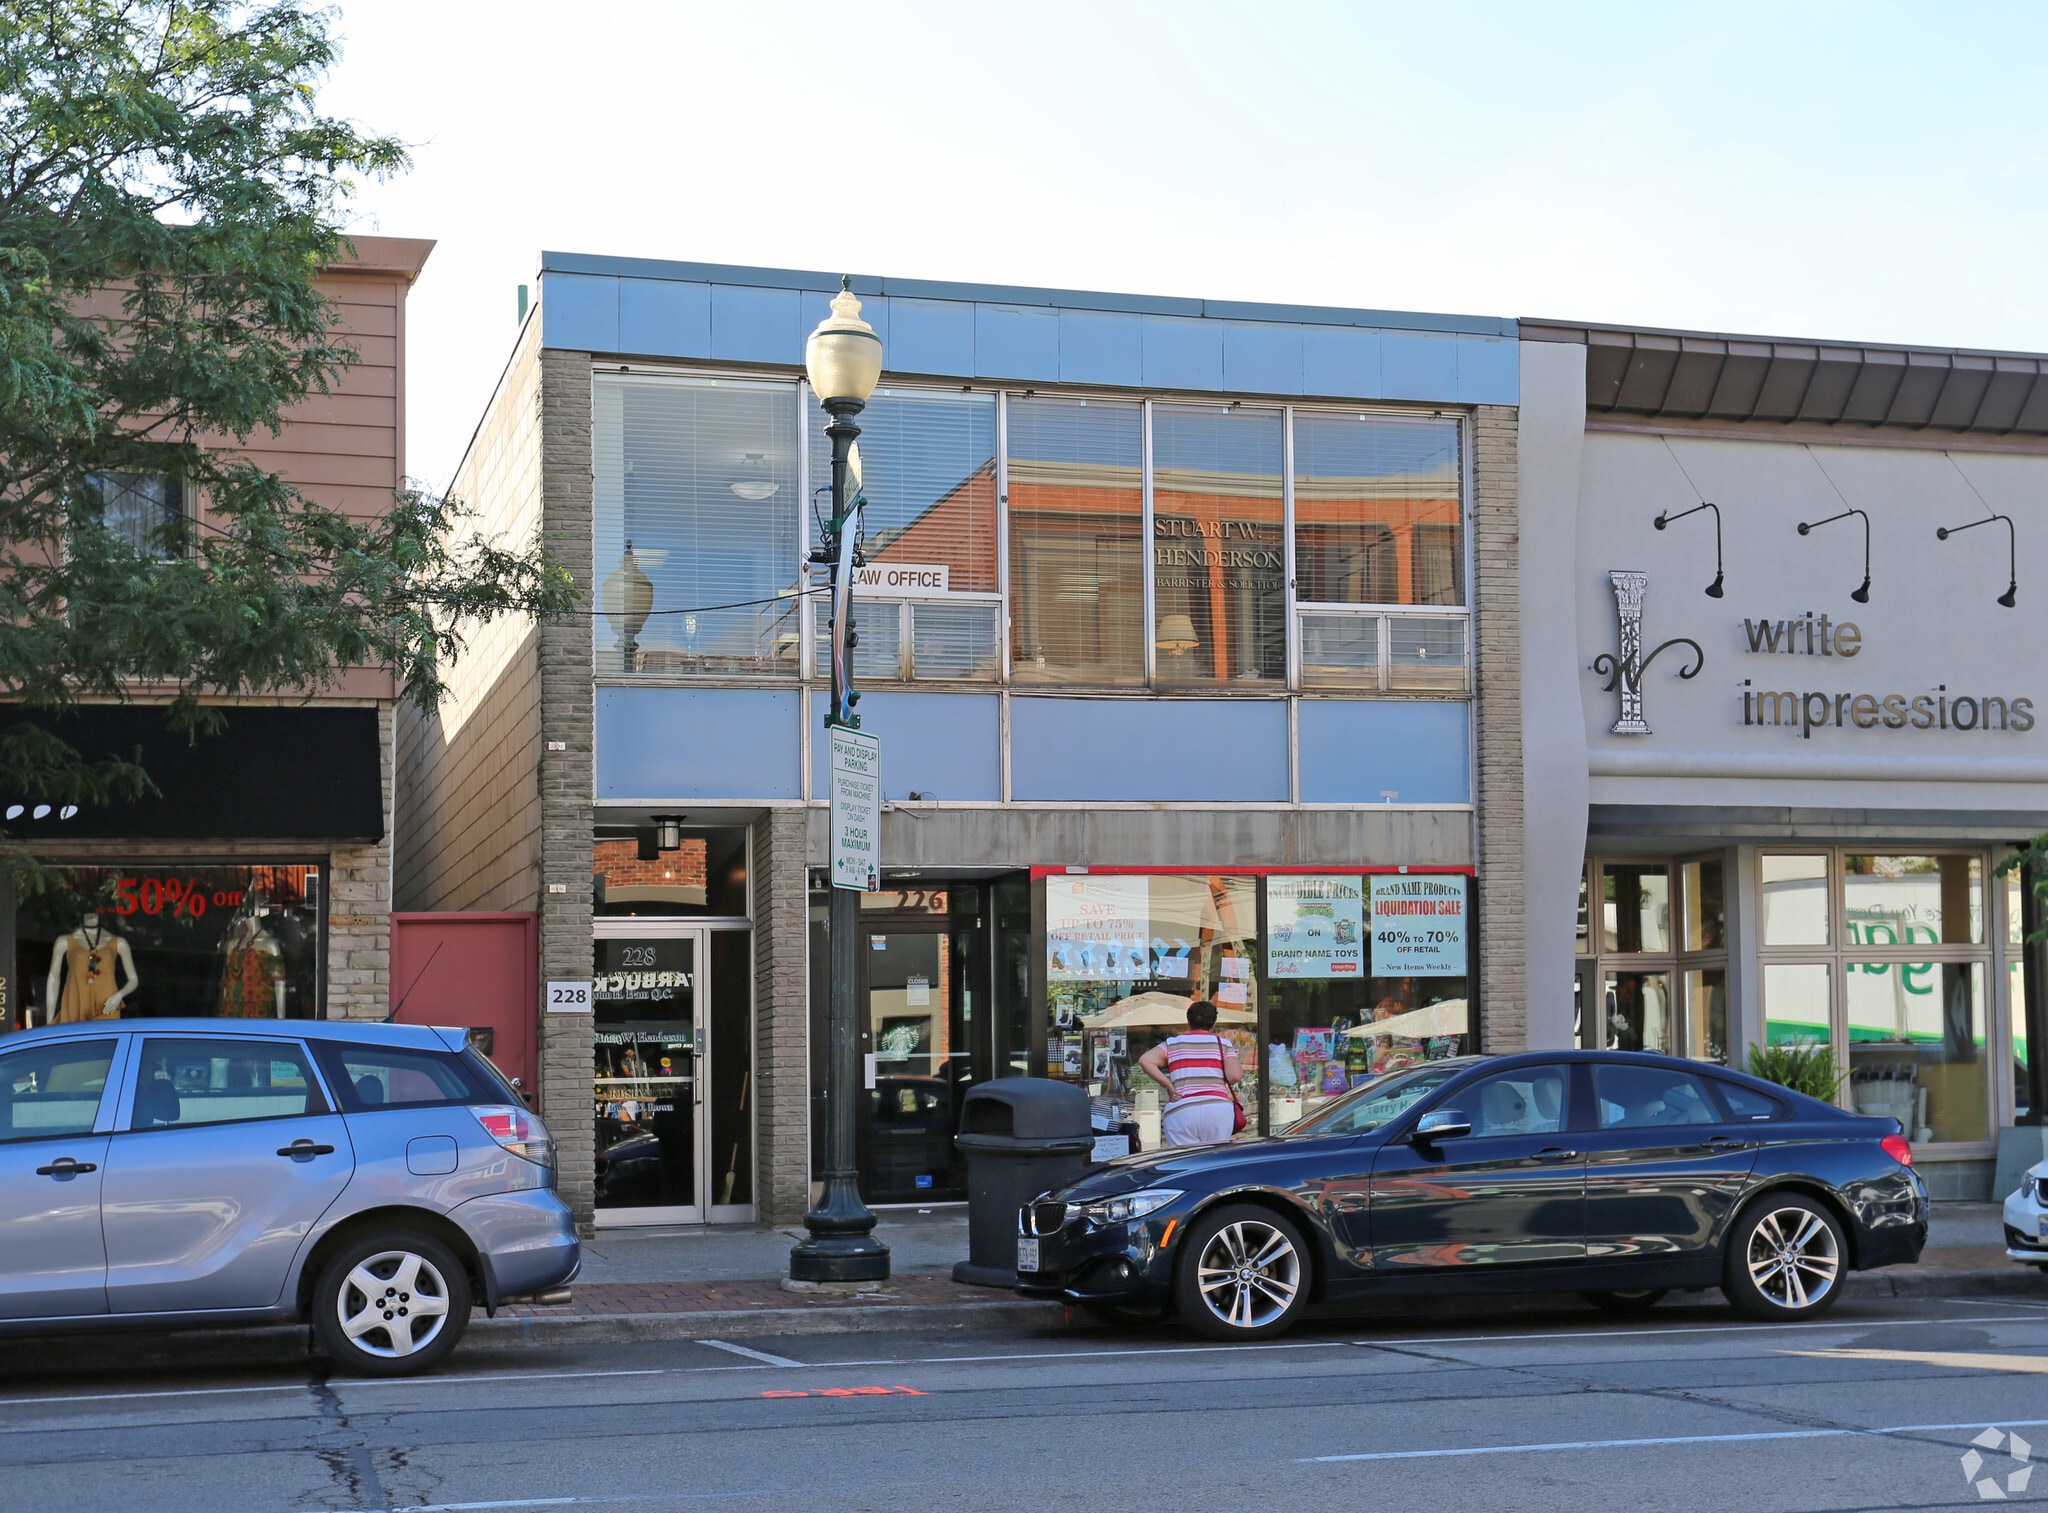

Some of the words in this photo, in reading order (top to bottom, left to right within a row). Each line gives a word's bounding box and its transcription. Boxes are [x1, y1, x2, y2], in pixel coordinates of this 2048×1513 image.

[1155, 519, 1234, 539] STUART
[1237, 521, 1262, 539] W.
[1155, 548, 1282, 569] HENDERSON
[852, 569, 881, 585] AW
[887, 570, 942, 588] OFFICE
[1156, 578, 1216, 589] BARRISTER
[1217, 579, 1227, 589] &
[1229, 580, 1282, 591] SOLICITOR
[1744, 611, 1862, 657] write
[1744, 679, 2035, 739] impressions
[833, 743, 844, 754] PAY
[844, 745, 856, 757] AND
[856, 748, 878, 762] DISPLAY
[844, 757, 868, 772] PARKING
[840, 787, 853, 797] FROM
[860, 782, 874, 793] TICKET
[840, 802, 857, 812] DISPLAY
[857, 805, 872, 815] TICKET
[847, 812, 854, 821] ON
[854, 814, 866, 823] DASH
[844, 826, 849, 836] 3
[849, 827, 868, 840] HOUR
[841, 838, 871, 852] MAXIMUM
[1268, 880, 1324, 899] INCREDIBLE
[1325, 881, 1359, 899] PRICES
[1375, 883, 1400, 896] BRAND
[1401, 881, 1422, 896] NAME
[1423, 881, 1462, 896] PRODUCTS
[116, 877, 207, 918] 50%
[213, 890, 243, 907] Off
[895, 890, 943, 912] 226
[1080, 904, 1116, 915] SAVE
[1375, 900, 1436, 917] LIQUIDATION
[1438, 900, 1462, 916] SALE
[1061, 918, 1080, 930] UP
[1083, 918, 1104, 930] TO
[1107, 918, 1134, 930] 75%
[1050, 932, 1072, 941] OFF
[1074, 932, 1112, 941] RETAIL
[1114, 931, 1145, 941] PRICE
[1307, 929, 1321, 937] ON
[1377, 930, 1411, 943] 40%
[1426, 930, 1459, 943] 70%
[622, 947, 657, 966] 228
[1271, 950, 1303, 958] BRAND
[1305, 949, 1332, 958] NAME
[1334, 949, 1359, 958] TOYS
[1396, 946, 1412, 954] OFF
[1386, 963, 1401, 971] New
[1403, 963, 1424, 971] Items
[1426, 963, 1452, 971] Weekly
[552, 989, 587, 1003] 228
